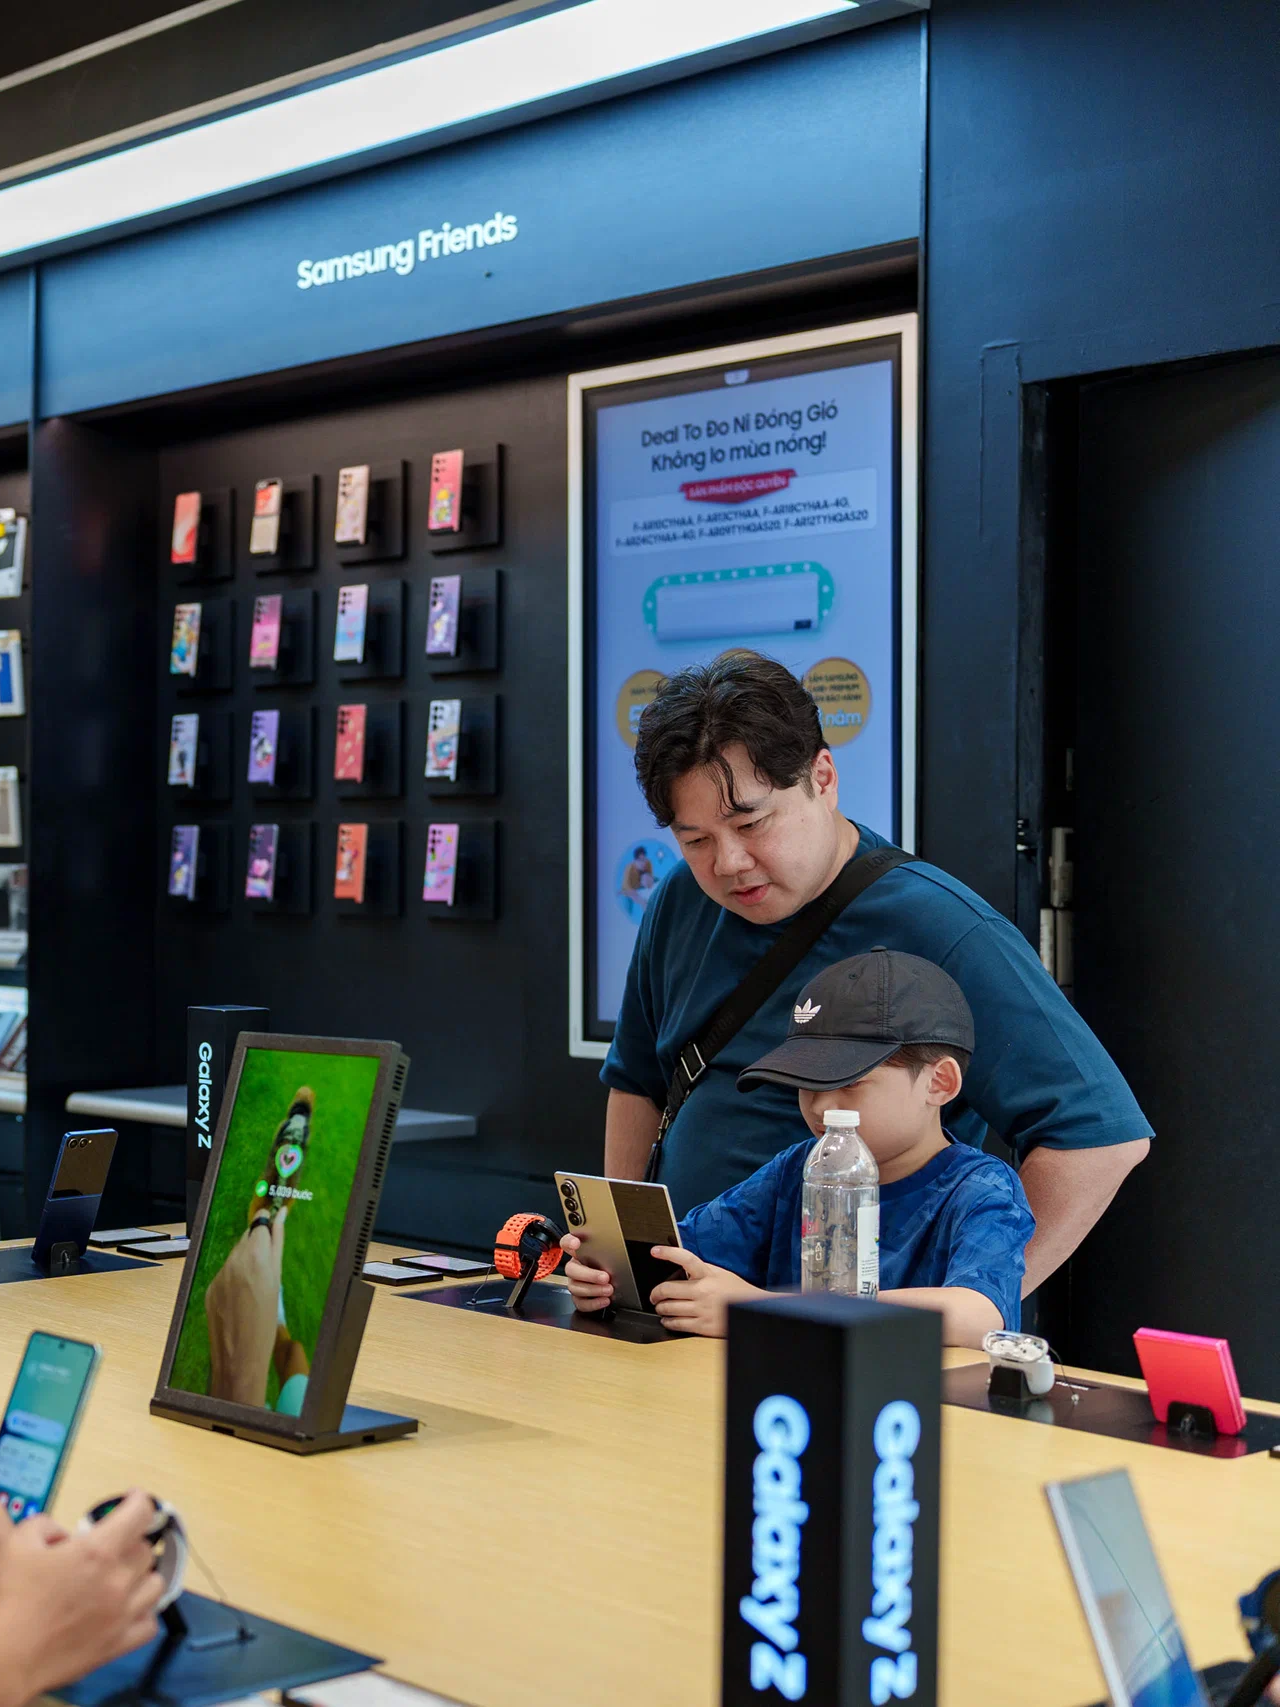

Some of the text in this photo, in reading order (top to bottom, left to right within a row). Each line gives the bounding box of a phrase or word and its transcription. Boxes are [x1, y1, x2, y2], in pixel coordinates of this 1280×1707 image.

[297, 211, 518, 290] Samsung Friends
[640, 425, 679, 447] Deal
[682, 423, 702, 440] To
[706, 420, 730, 438] Đo
[651, 448, 706, 472] Không
[710, 446, 725, 464] lo
[730, 439, 771, 462] mùa
[195, 1041, 213, 1149] Galaxy Z
[739, 1393, 811, 1702] Galaxy Z
[861, 1399, 921, 1706] Galaxy Z
